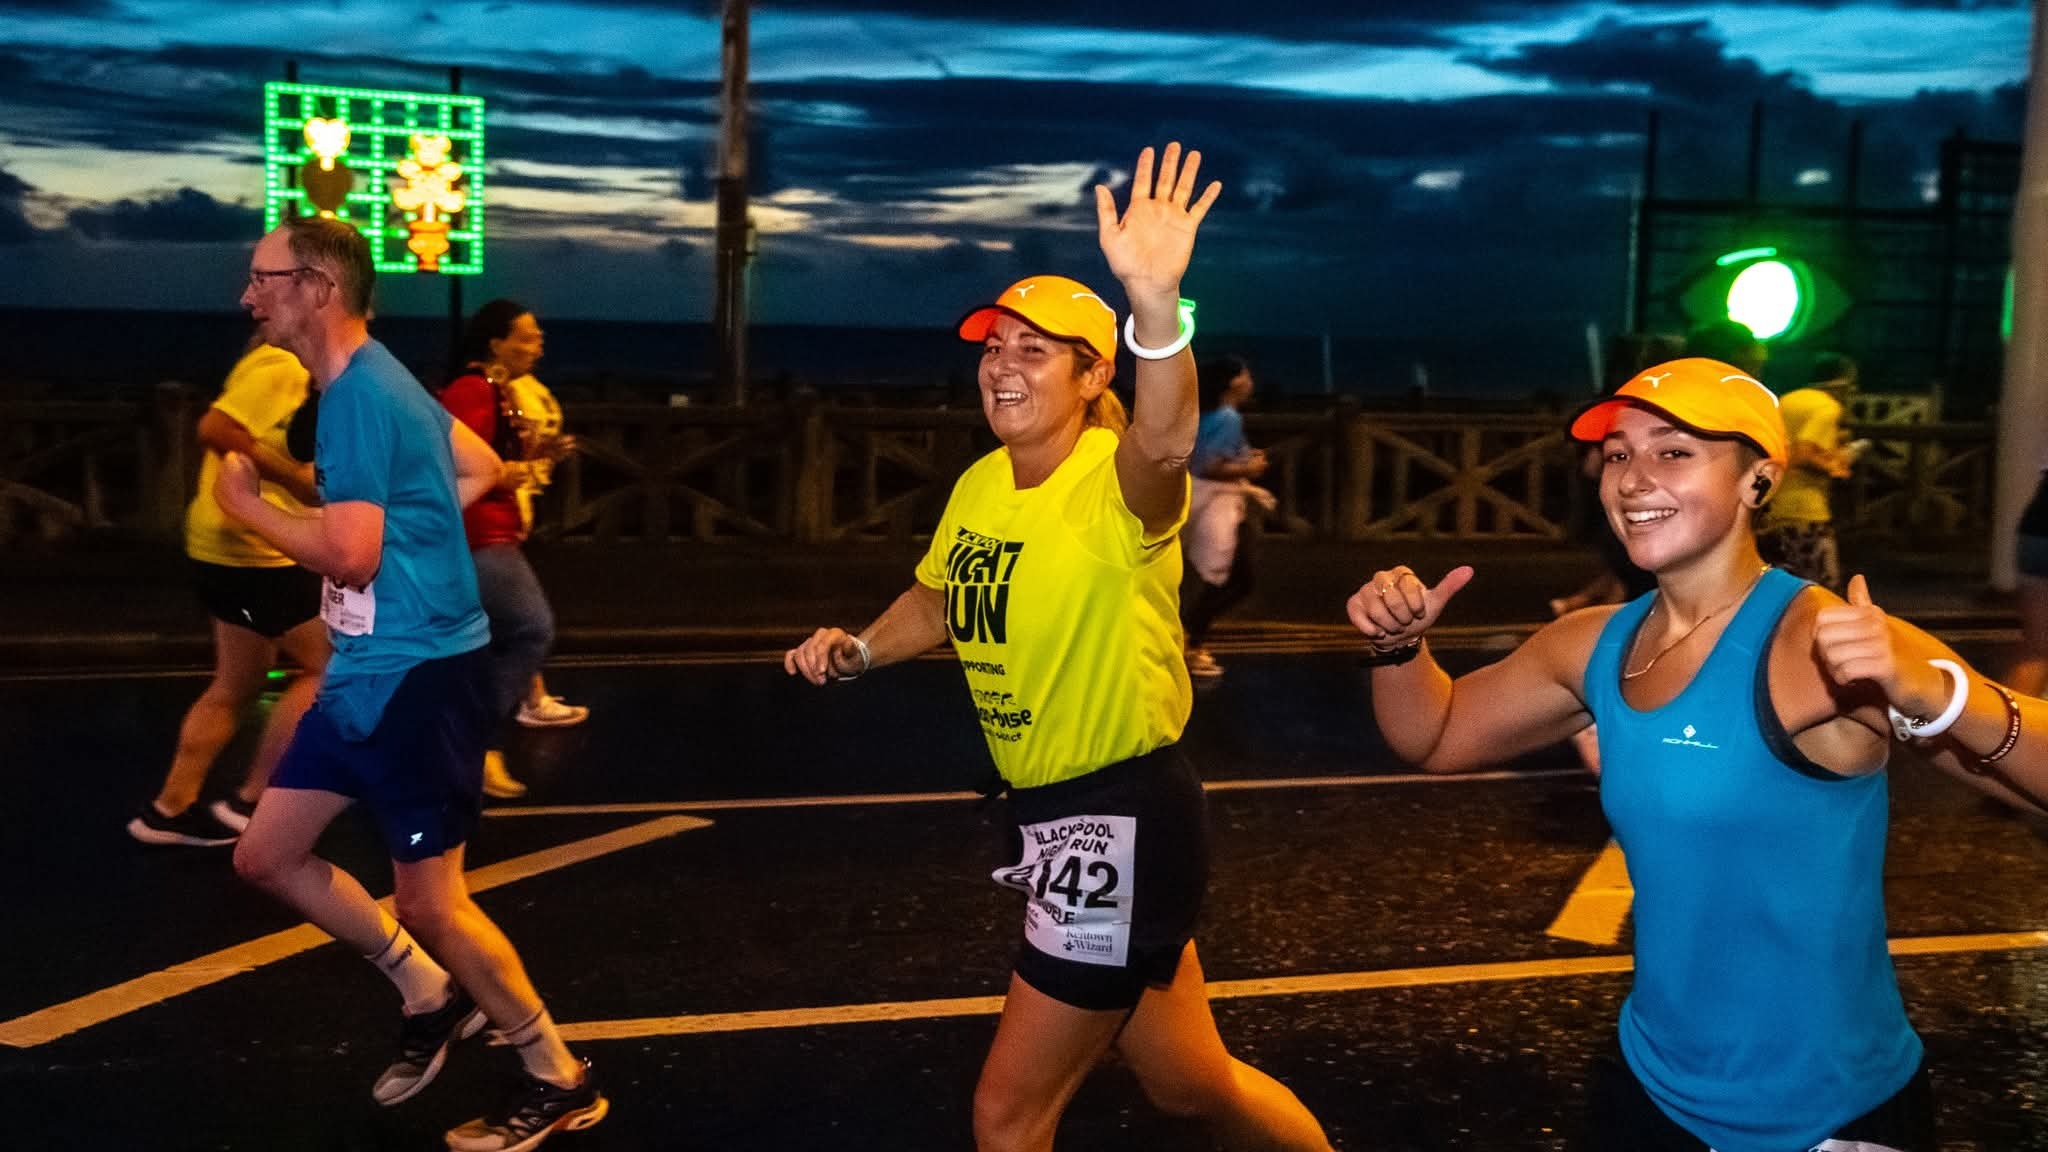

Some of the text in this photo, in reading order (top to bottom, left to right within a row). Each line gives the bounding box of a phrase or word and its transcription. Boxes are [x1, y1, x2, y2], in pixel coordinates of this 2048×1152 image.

[945, 582, 1009, 644] UN
[1037, 838, 1109, 861] NIG RUN
